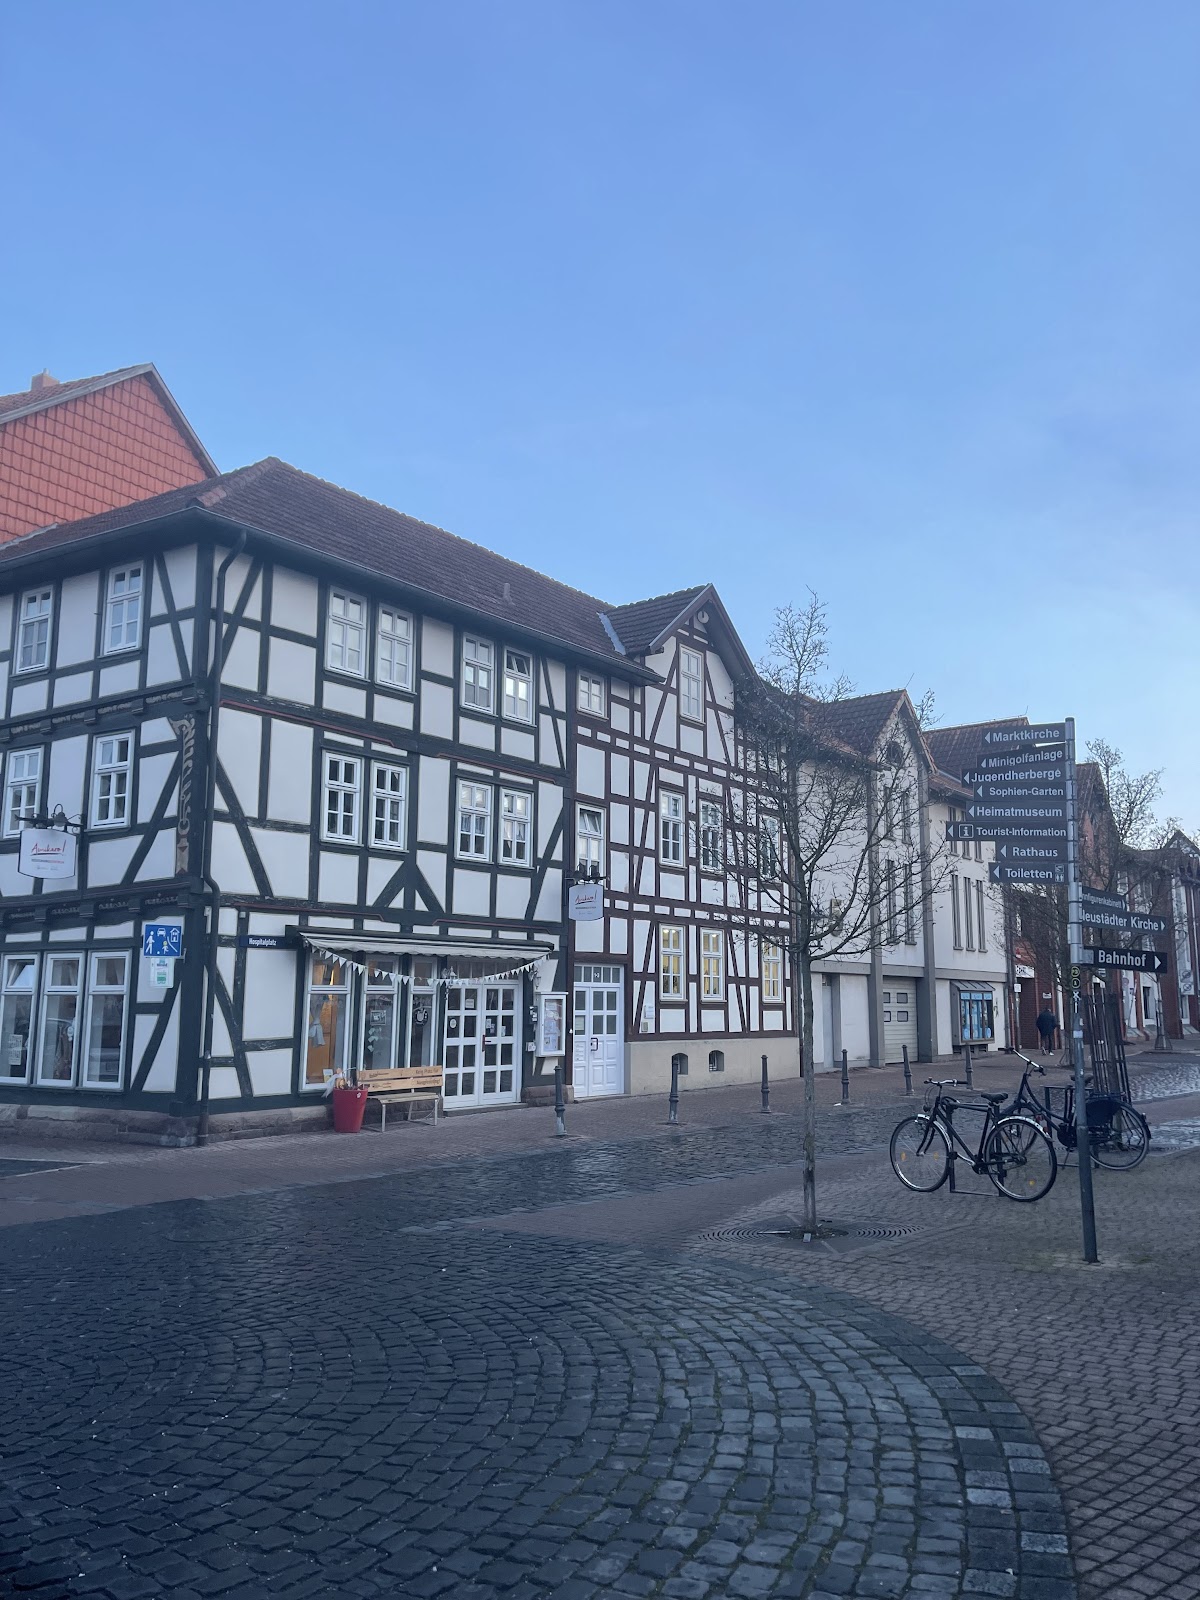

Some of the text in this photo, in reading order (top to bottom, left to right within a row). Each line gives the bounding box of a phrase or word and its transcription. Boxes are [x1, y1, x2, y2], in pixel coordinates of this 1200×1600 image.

[992, 729, 1060, 742] Marktkirche
[988, 750, 1063, 768] Minigolfanlage
[971, 769, 1061, 782] Jugendherberge
[989, 787, 1064, 797] Sophien-Garten
[976, 806, 1062, 817] Heimatmuseum
[976, 827, 1067, 837] Tourist-Information
[1012, 846, 1058, 857] Rathaus
[1005, 868, 1053, 879] Toiletten
[1130, 916, 1159, 931] Kirche
[1098, 949, 1147, 967] Bahnhof
